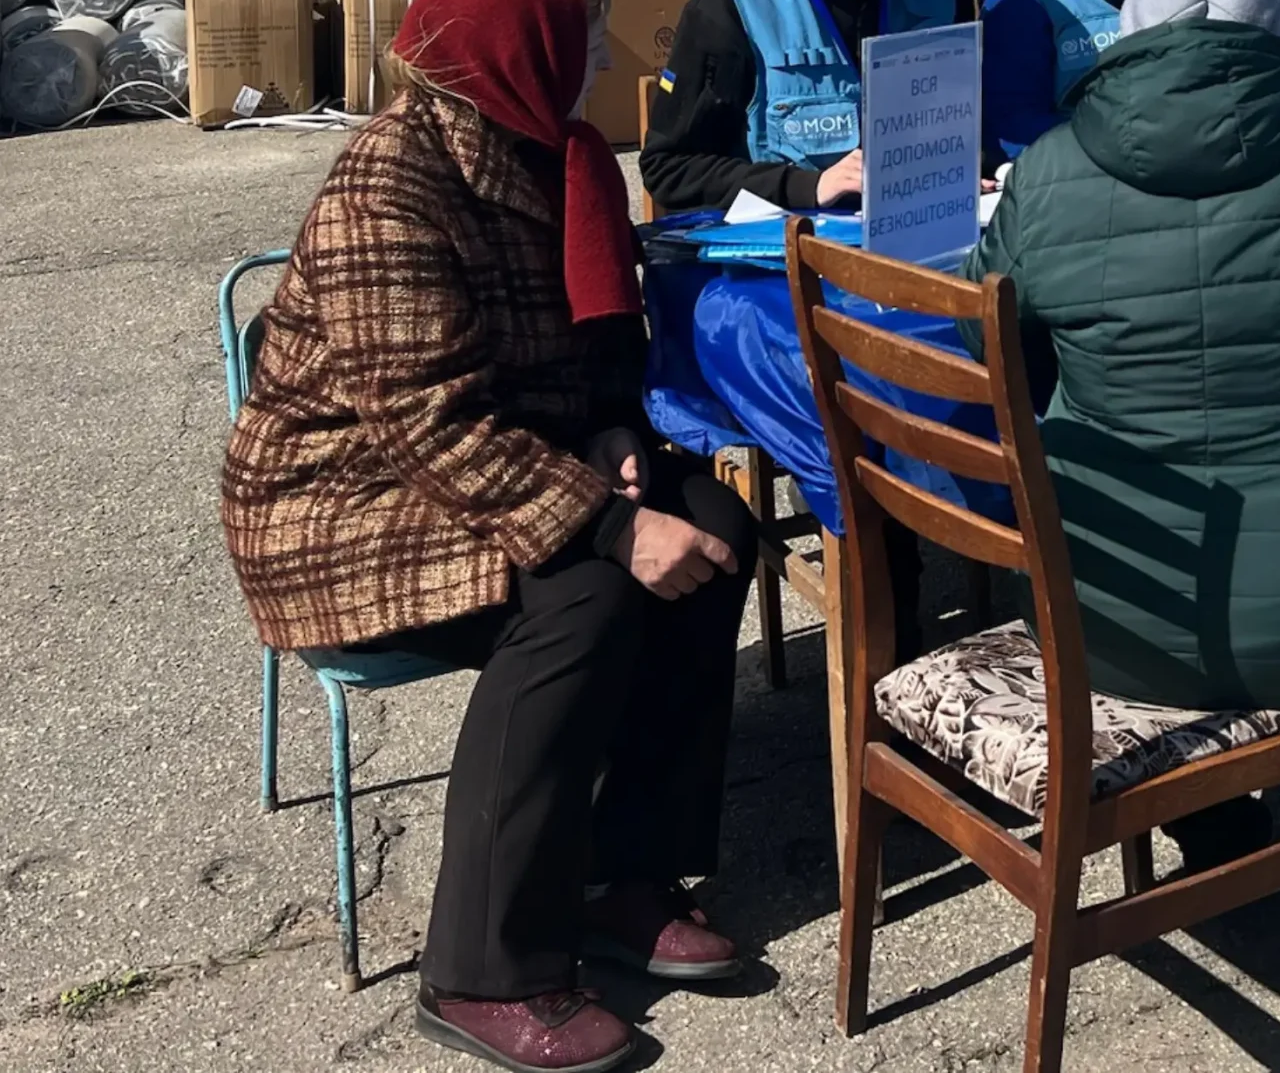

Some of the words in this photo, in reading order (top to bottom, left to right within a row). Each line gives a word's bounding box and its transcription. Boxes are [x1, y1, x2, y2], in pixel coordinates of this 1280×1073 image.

[911, 75, 938, 96] ВСЯ
[873, 100, 973, 138] ГУМАНІТАРНА
[881, 134, 965, 172] ДОПОМОГА
[881, 165, 965, 202] НАДАЄТЬСЯ
[869, 194, 976, 238] БЕЗКОШТОВНО
